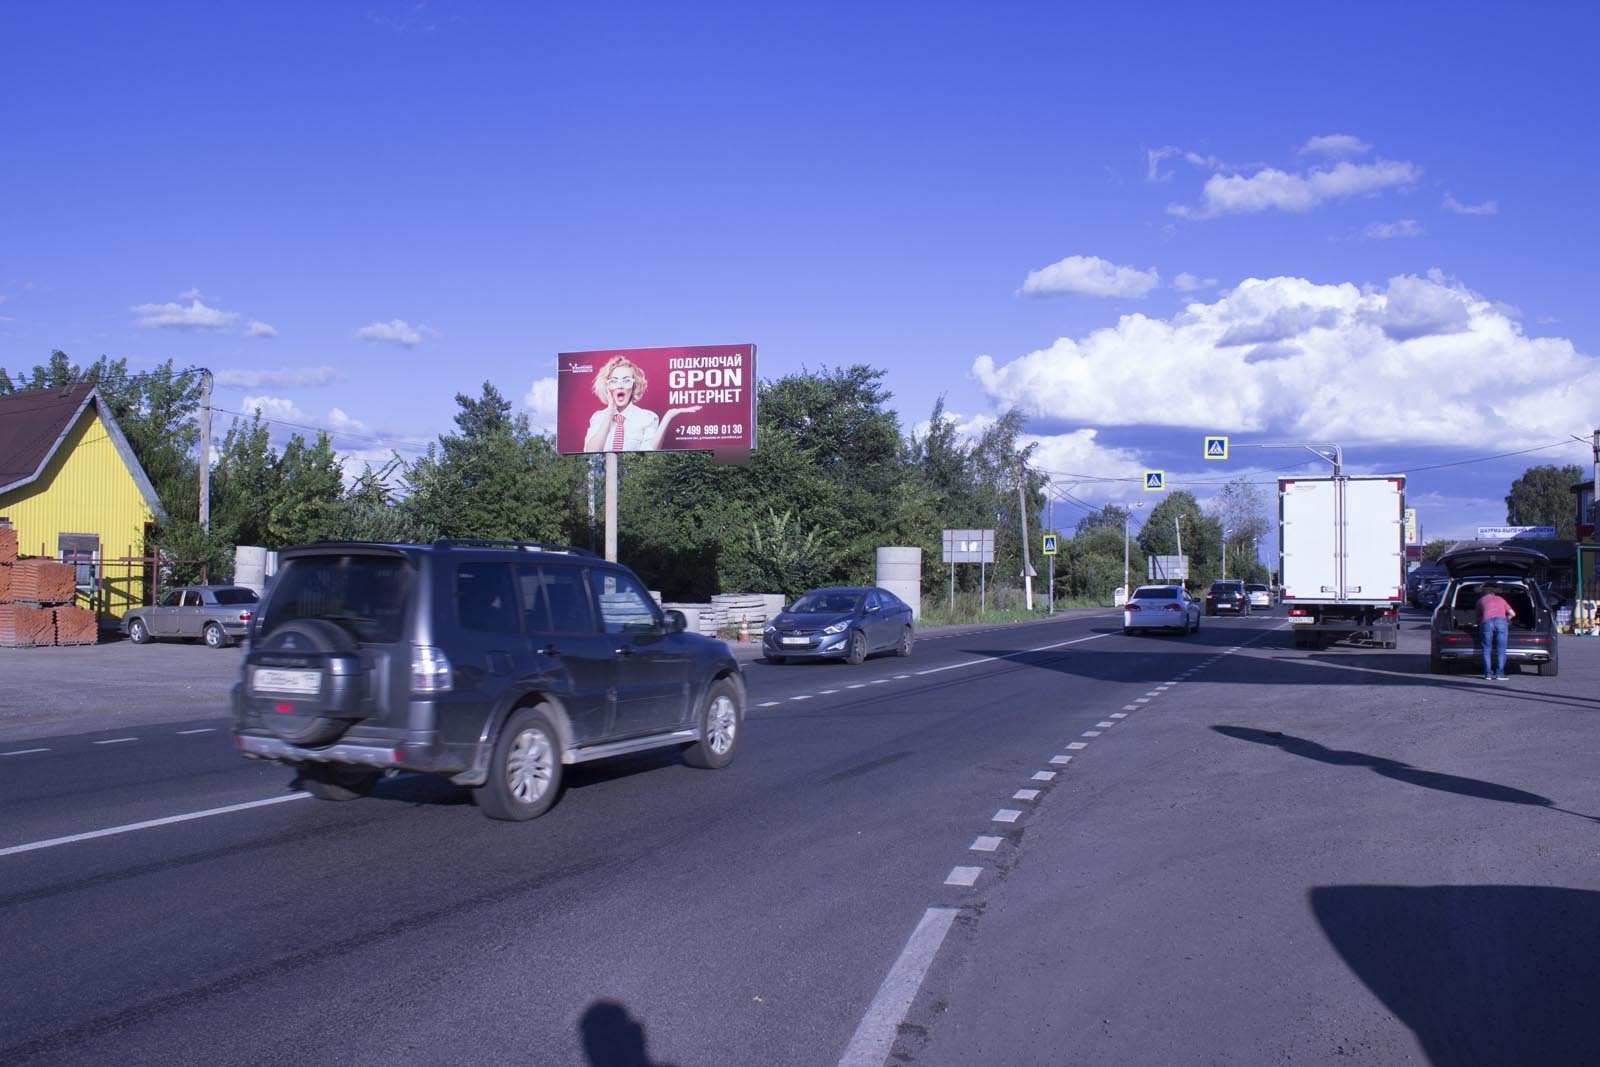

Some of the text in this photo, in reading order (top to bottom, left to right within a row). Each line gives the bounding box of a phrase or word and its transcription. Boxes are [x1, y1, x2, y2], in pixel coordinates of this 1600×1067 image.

[669, 353, 742, 369] ПОДКЛЮЧАЙ
[669, 368, 742, 389] GPON
[669, 389, 742, 405] ИНТЕРНЕТ
[675, 425, 685, 435] +7
[686, 425, 701, 435] 499
[704, 424, 719, 435] 999
